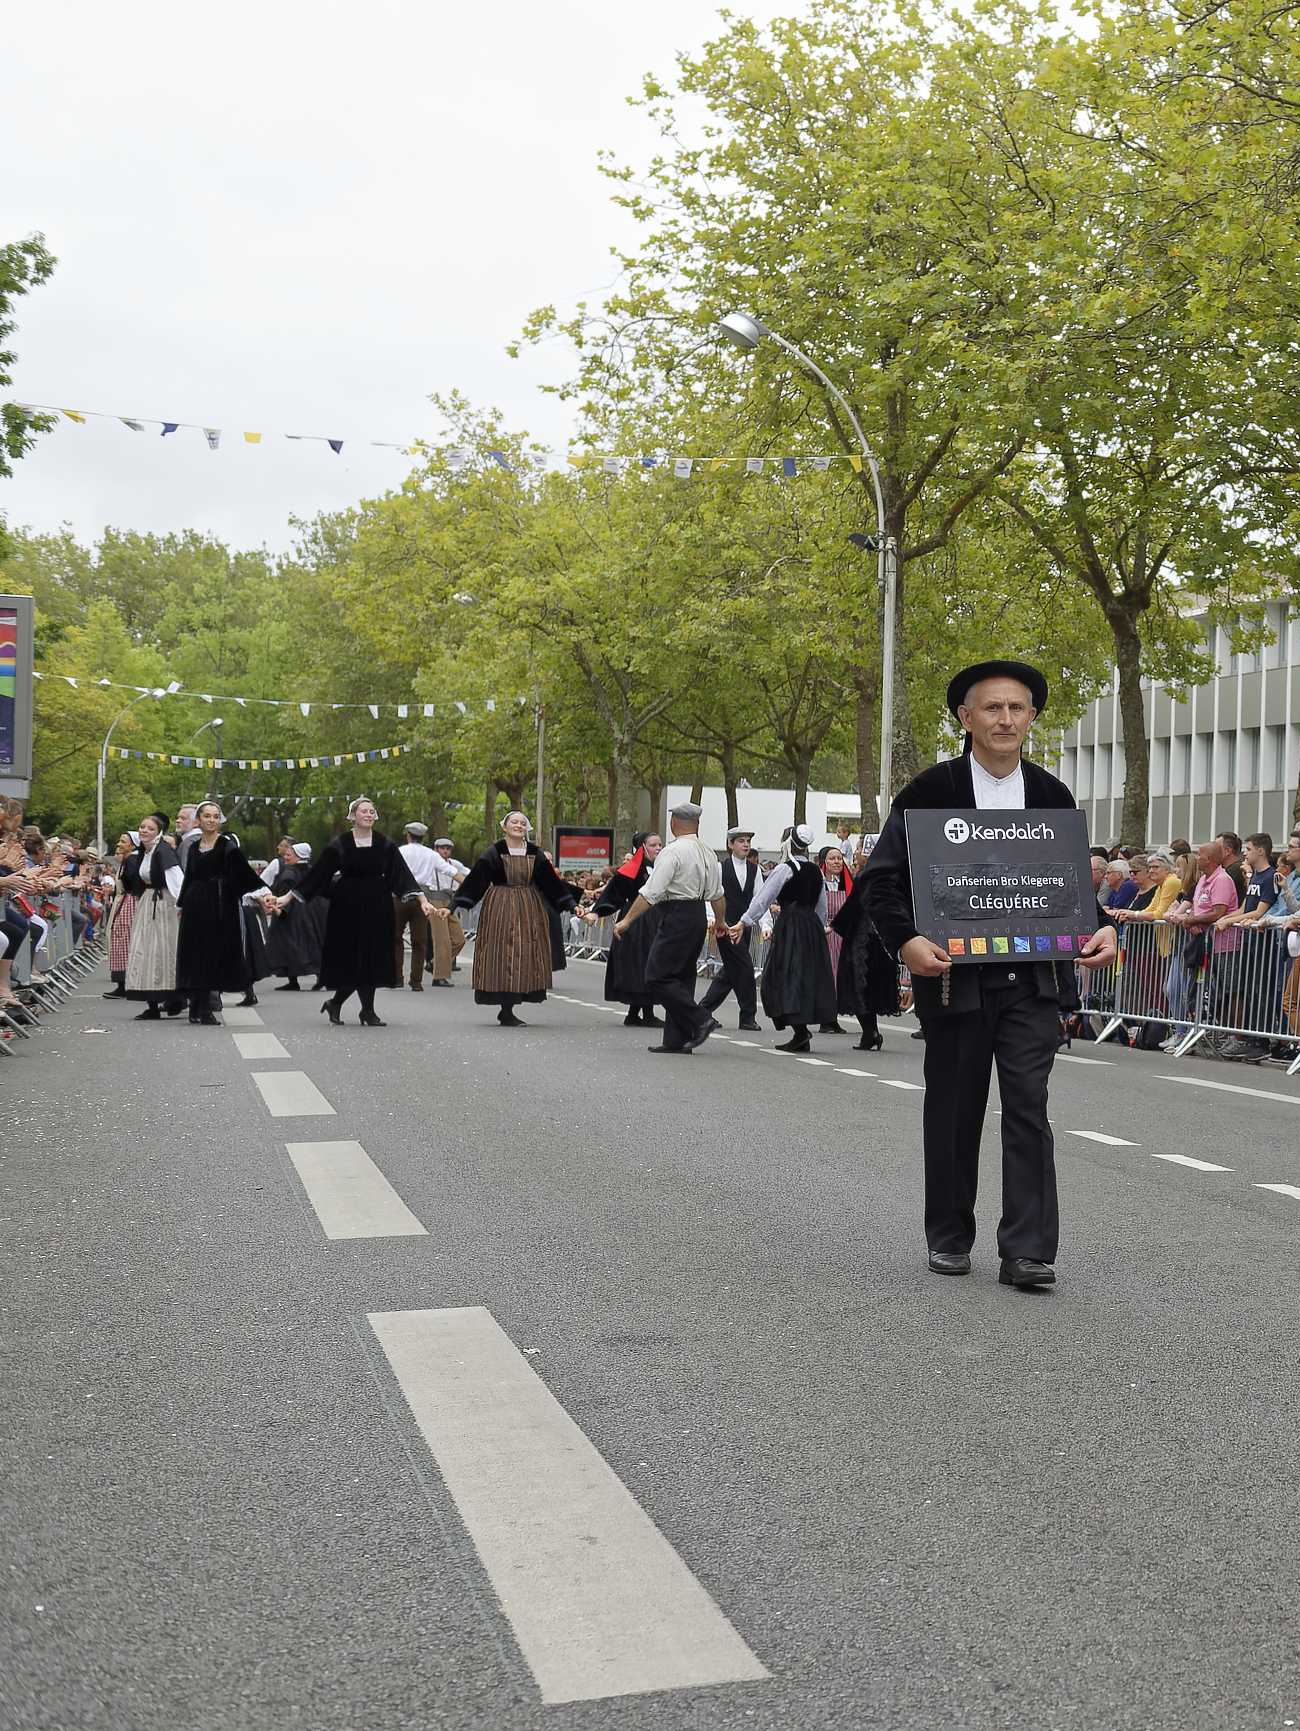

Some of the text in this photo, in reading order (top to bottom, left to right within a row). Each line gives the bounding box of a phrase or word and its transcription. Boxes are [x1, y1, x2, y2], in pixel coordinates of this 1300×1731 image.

[971, 823, 1054, 840] Kendalc'h
[947, 875, 1064, 888] Dañserien Bro Klegereg
[969, 893, 1048, 909] CLÉGUÉREC
